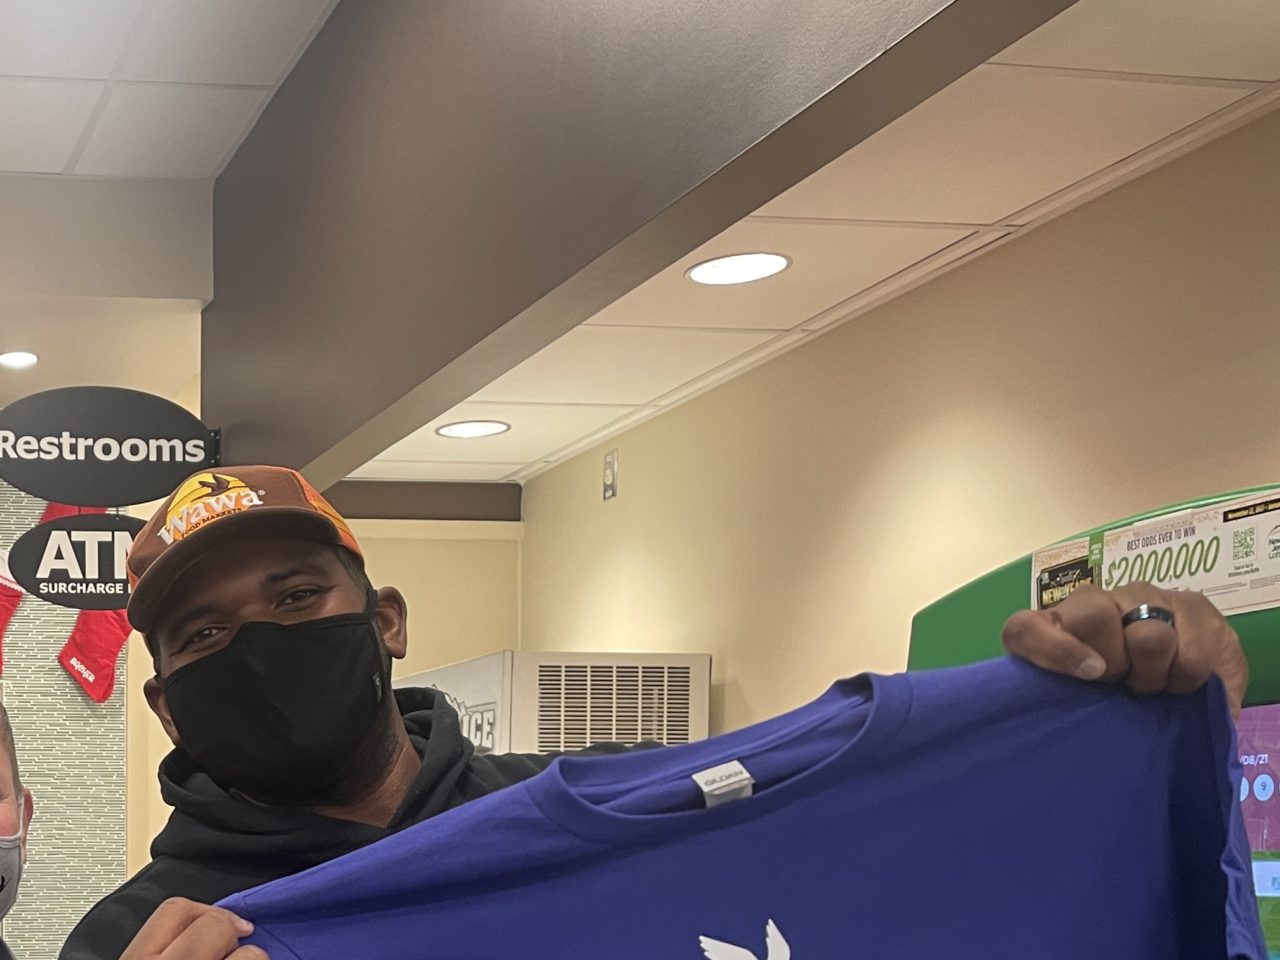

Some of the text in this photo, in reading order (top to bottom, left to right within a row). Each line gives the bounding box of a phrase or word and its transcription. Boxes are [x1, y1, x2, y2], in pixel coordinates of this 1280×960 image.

[157, 490, 263, 544] Wawa
[1127, 526, 1196, 551] BEST ODDS EVER TO WIN
[39, 582, 124, 594] SURCHARGE
